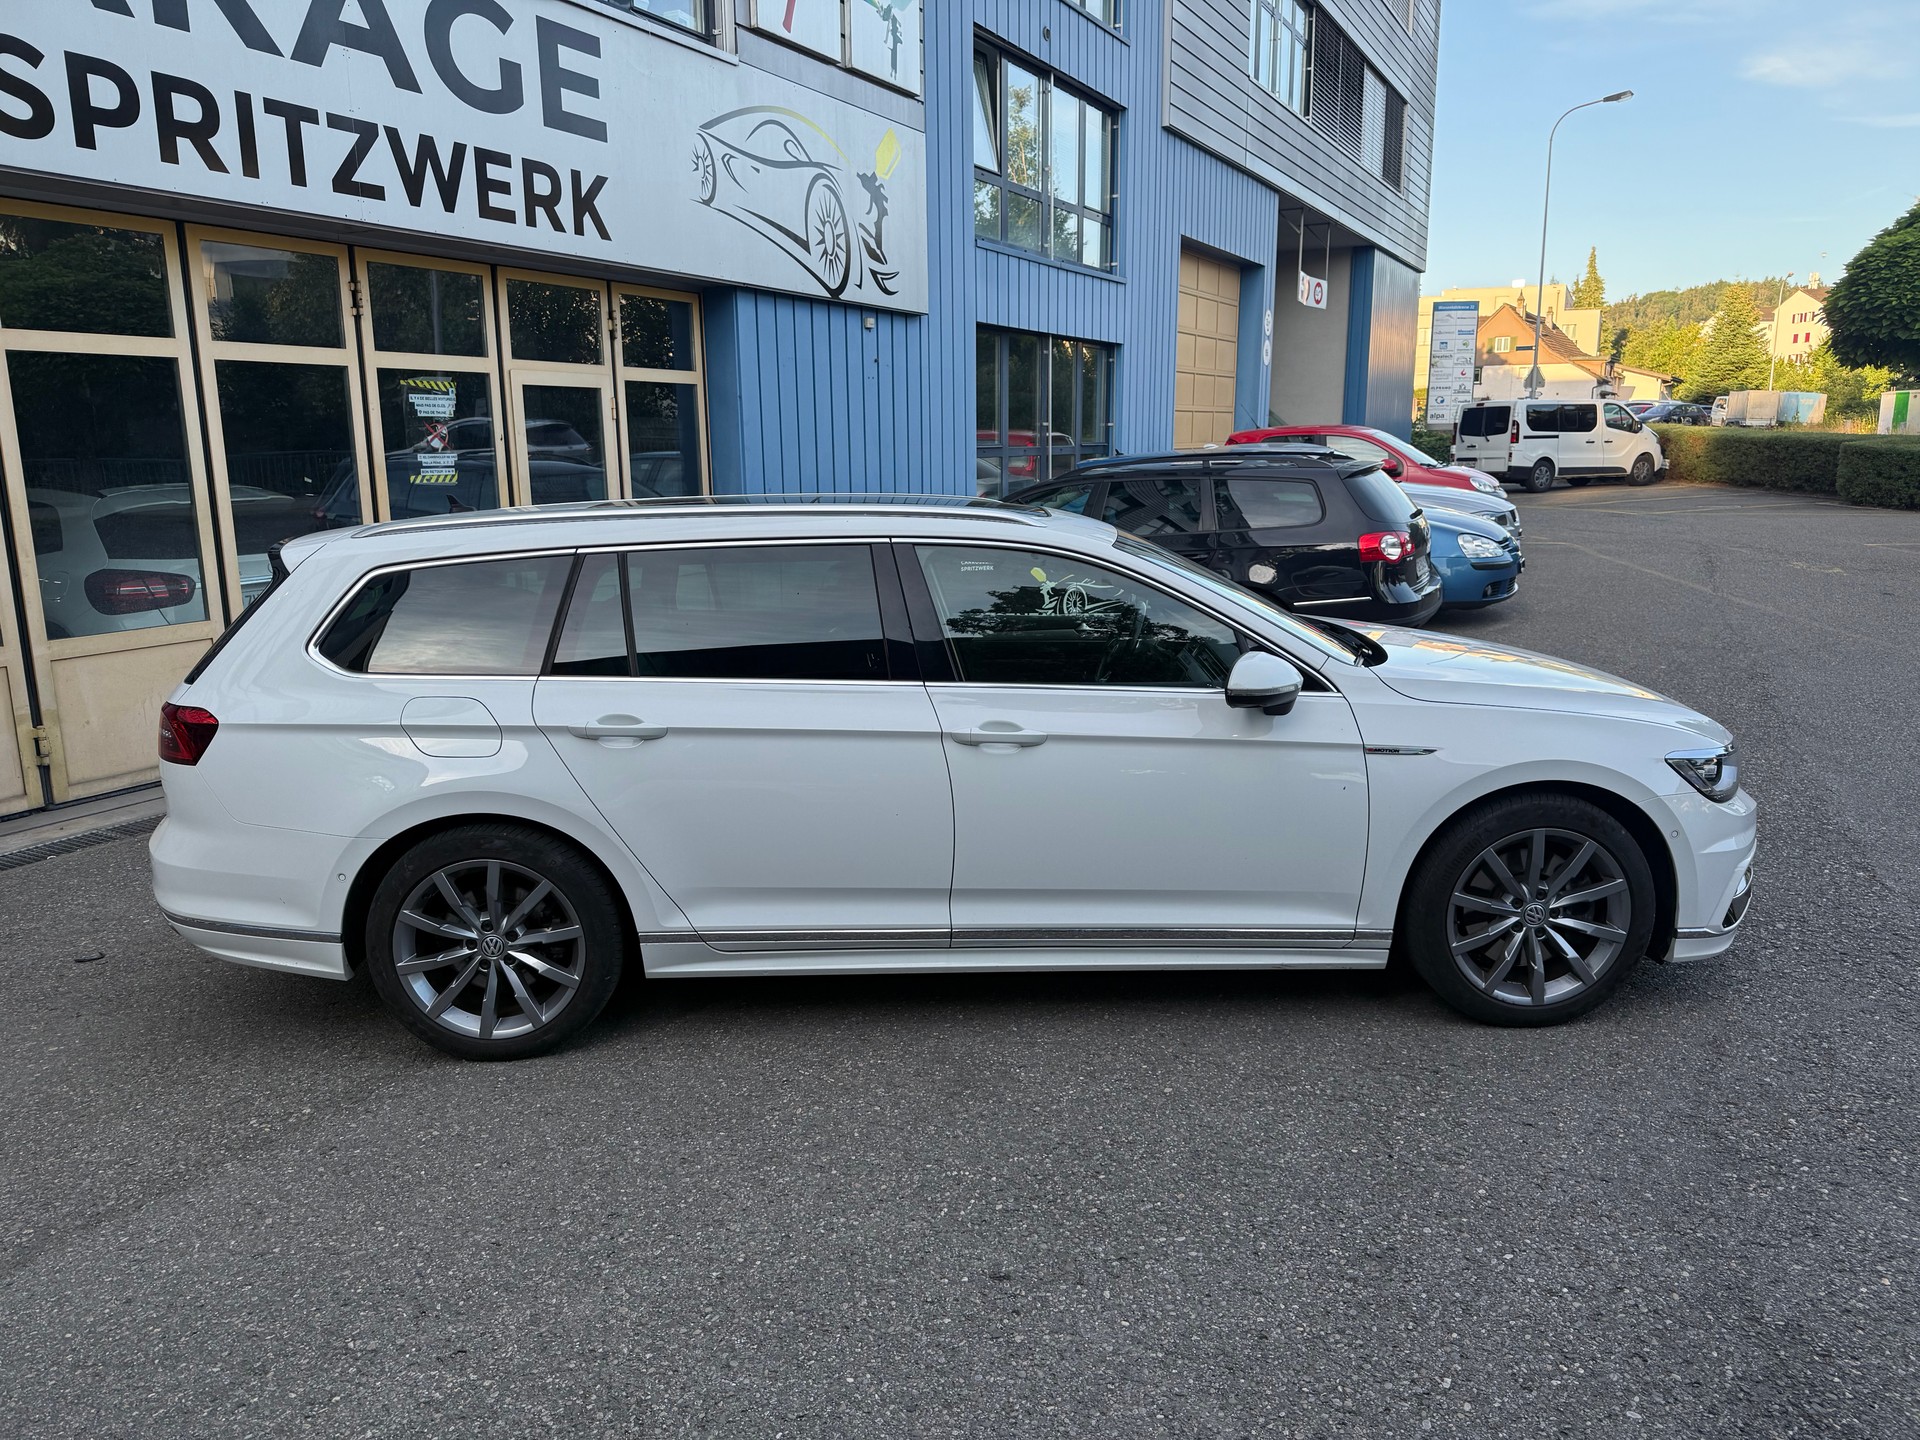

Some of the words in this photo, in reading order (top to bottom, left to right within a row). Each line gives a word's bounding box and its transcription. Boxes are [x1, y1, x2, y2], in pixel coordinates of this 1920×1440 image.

[0, 33, 612, 242] SPRITZWERK
[92, 0, 608, 143] AGE
[1429, 412, 1445, 420] alpa
